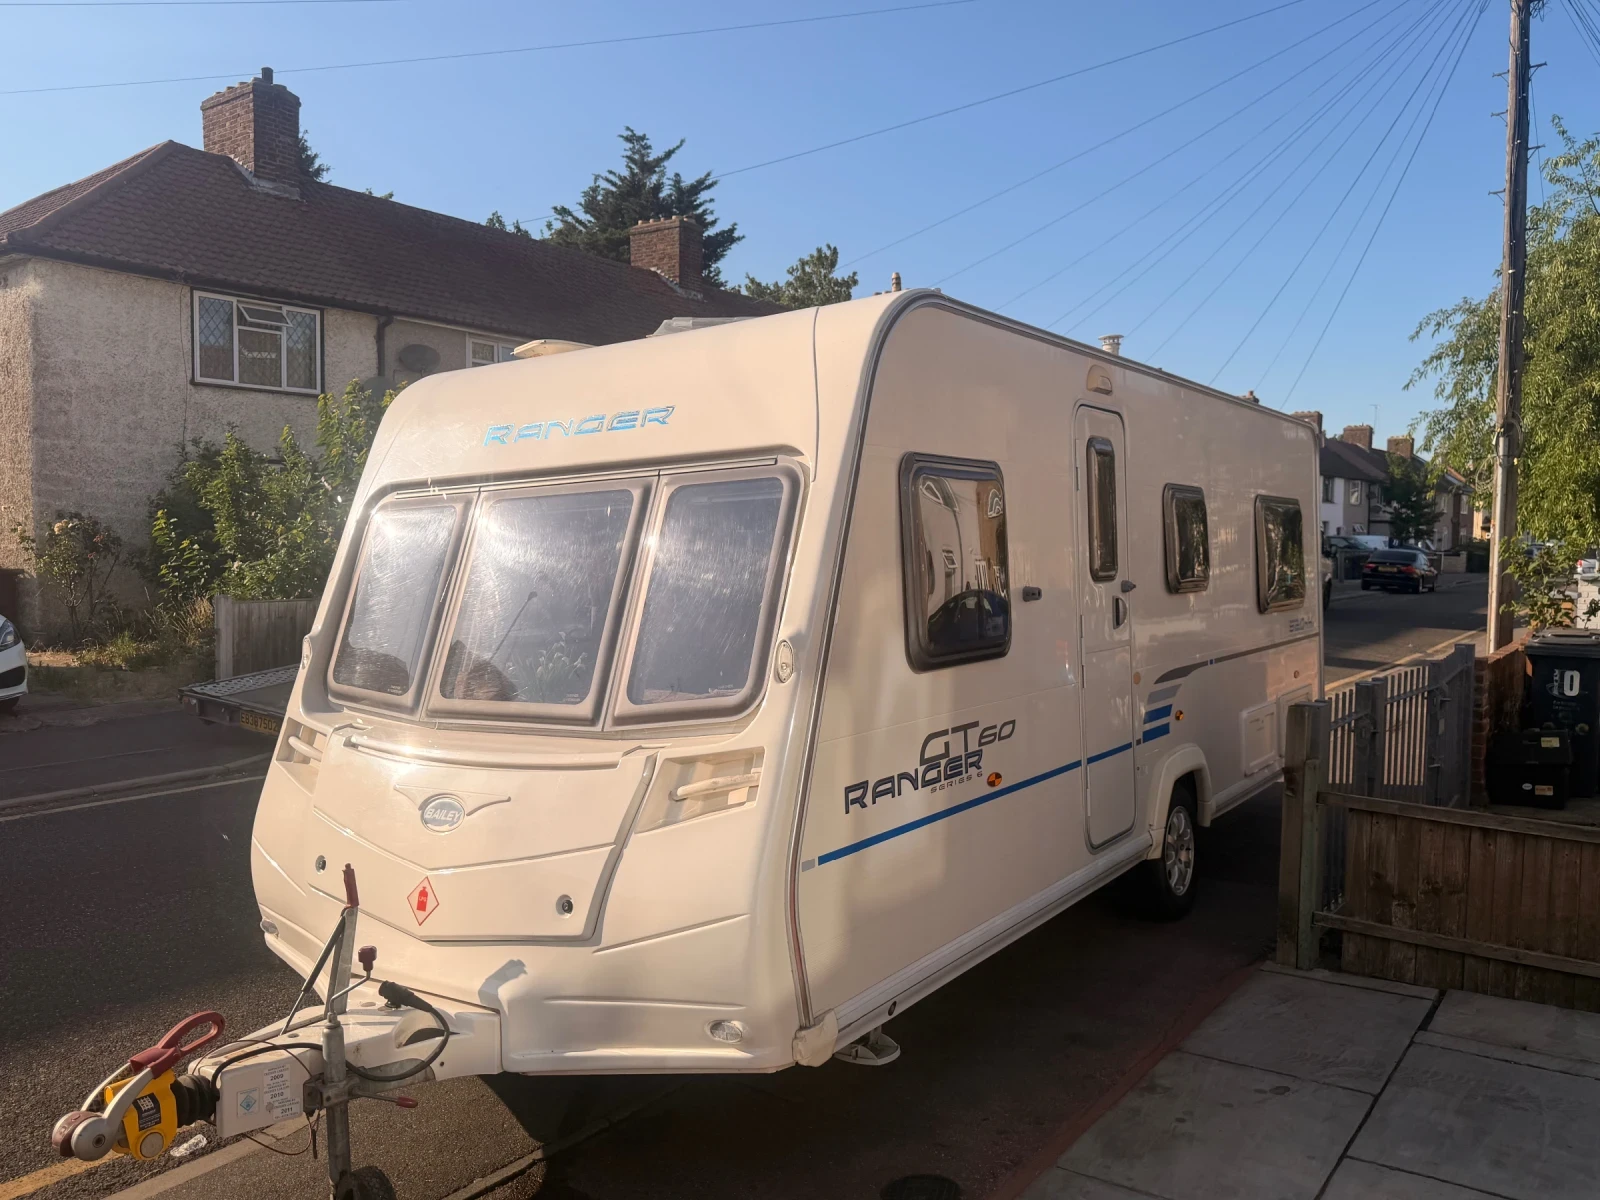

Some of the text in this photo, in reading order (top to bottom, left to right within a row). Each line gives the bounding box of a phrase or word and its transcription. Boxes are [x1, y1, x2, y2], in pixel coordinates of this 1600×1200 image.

[483, 405, 676, 446] RANGER
[844, 748, 983, 814] RANGER
[930, 774, 973, 794] SERIES
[425, 808, 462, 822] BAILEY
